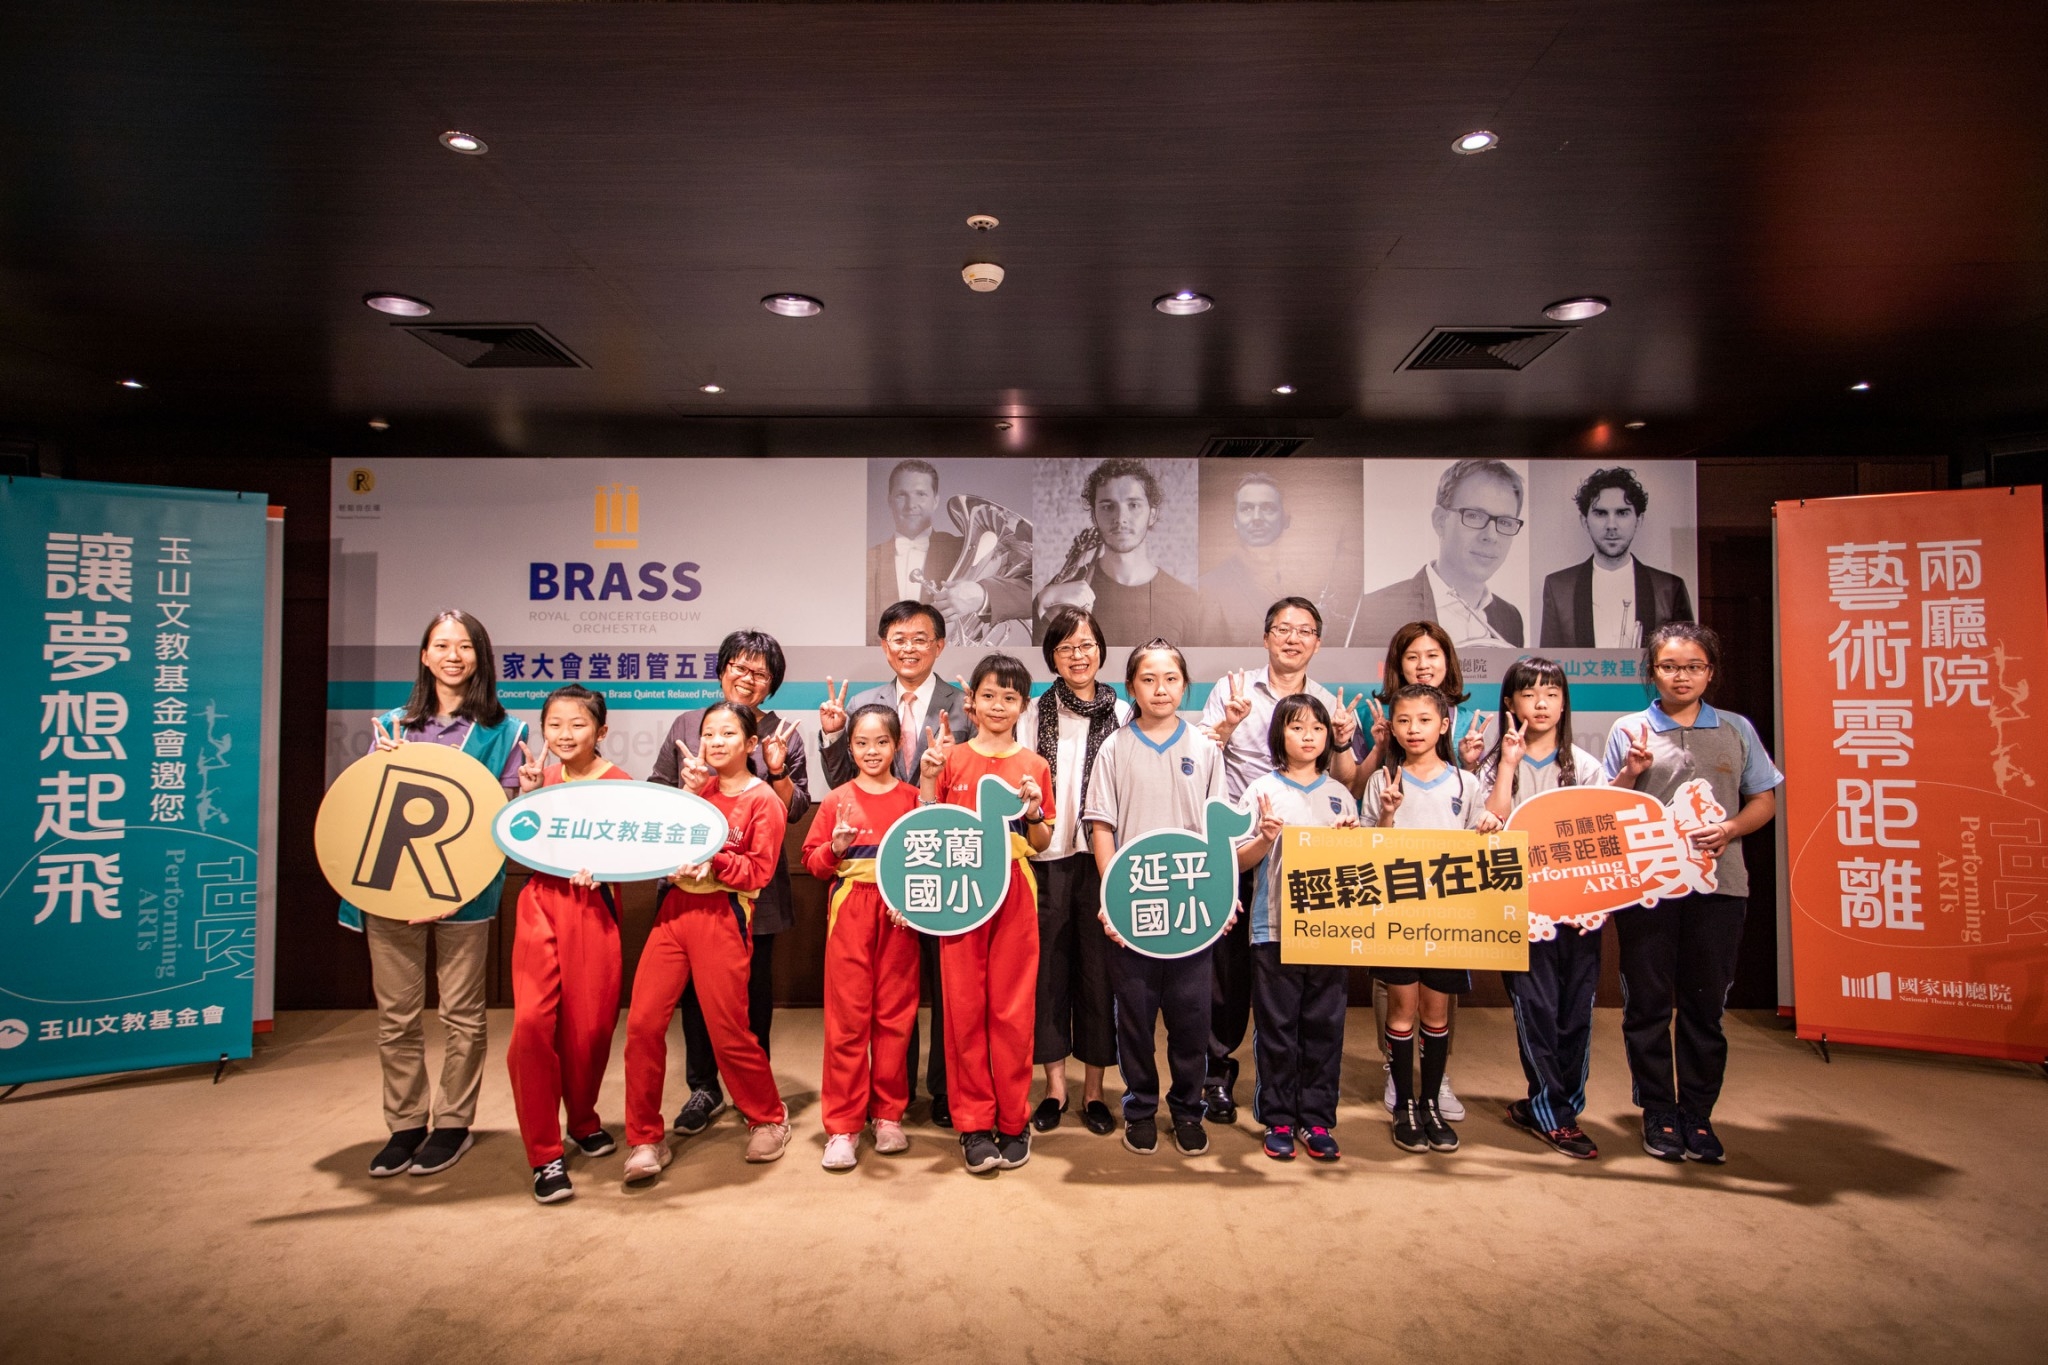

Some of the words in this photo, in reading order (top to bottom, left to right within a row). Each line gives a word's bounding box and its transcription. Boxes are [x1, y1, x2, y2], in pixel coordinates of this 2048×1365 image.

[530, 562, 702, 601] BRASS
[529, 611, 570, 621] ROYAL
[579, 611, 701, 622] CONCERTGEBOUW
[572, 623, 657, 634] ORCHESTRA
[1917, 539, 1991, 708] 兩廳院
[150, 537, 191, 822] 玉山文教基金會邀您
[609, 690, 632, 699] Brass
[634, 690, 665, 701] Quintet
[668, 690, 700, 699] Relaxed
[33, 532, 134, 925] 讓夢想起飛
[1827, 540, 1925, 931] 藝術零距離
[351, 764, 474, 902] R
[547, 816, 712, 847] 玉山文教基金會
[1299, 831, 1363, 847] Relaxed
[1372, 834, 1477, 851] Performance
[1554, 813, 1617, 838] 兩廳院
[903, 828, 983, 869] 愛蘭
[1129, 850, 1211, 894] 延平
[1287, 847, 1523, 915] 輕鬆自在場
[1583, 873, 1641, 894] ARTs
[1938, 852, 1960, 913] ARTs
[1960, 816, 1986, 943] Performing
[155, 849, 185, 979] Performing
[904, 873, 984, 914] 國小
[137, 887, 158, 951] ARTs
[1130, 896, 1211, 937] 國小
[1293, 919, 1376, 939] Relaxed
[1388, 922, 1522, 944] Performance
[1897, 976, 2012, 1003] 國家兩廳院
[38, 1004, 226, 1042] 玉山文教基金會
